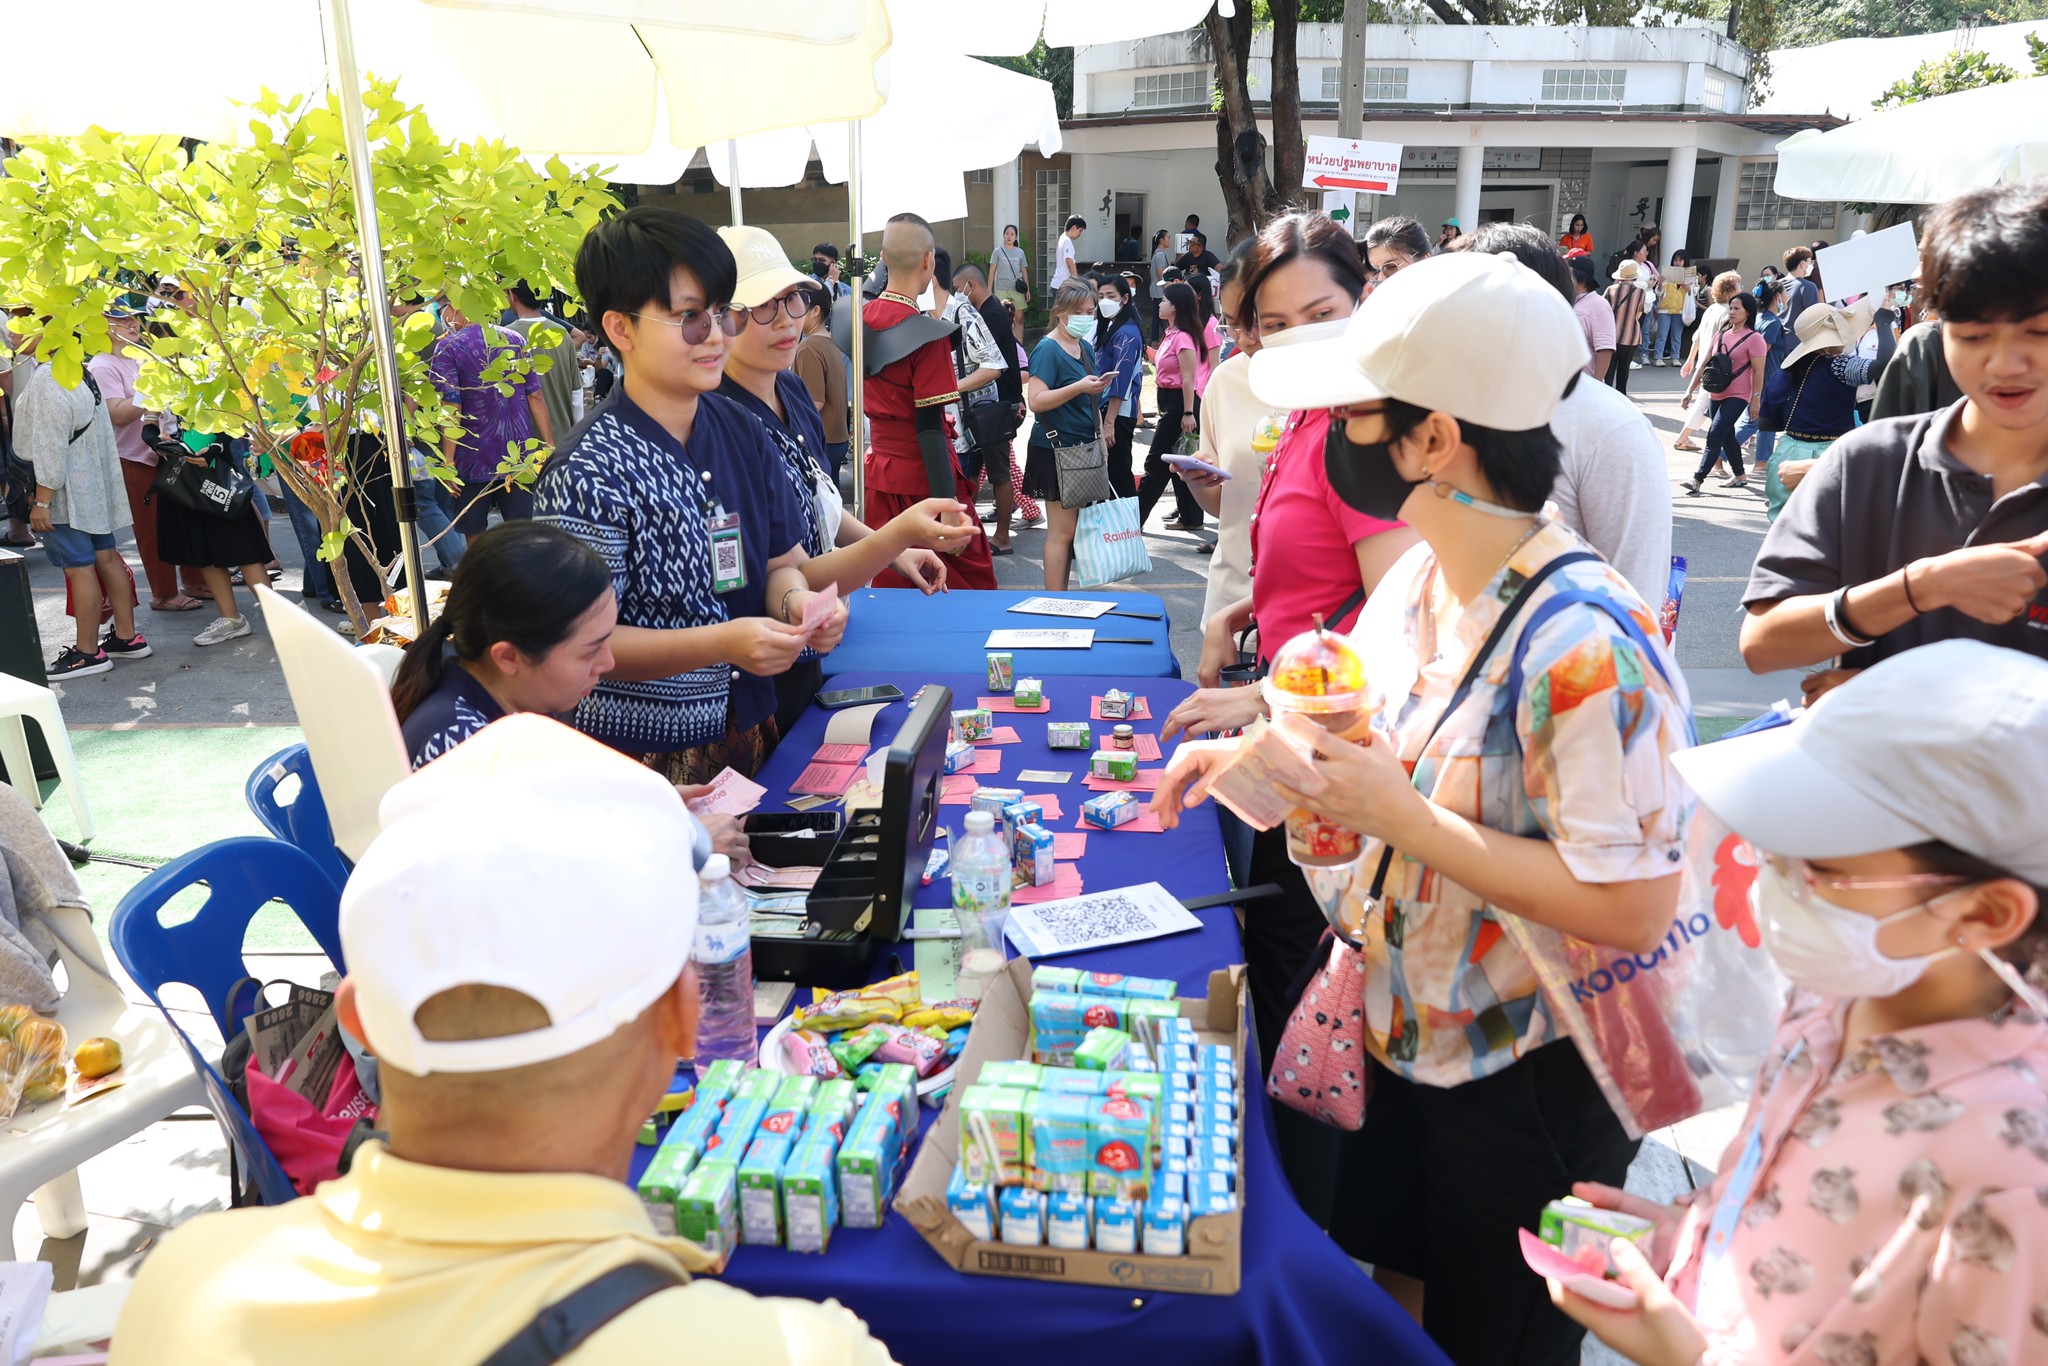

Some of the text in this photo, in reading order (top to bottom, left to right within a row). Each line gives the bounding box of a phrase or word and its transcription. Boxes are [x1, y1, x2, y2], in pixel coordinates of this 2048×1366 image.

[1307, 153, 1398, 172] หน่วยปฐมพยาบาล
[298, 989, 328, 1006] 2566
[263, 1005, 294, 1026] 2566
[328, 1089, 371, 1120] euse
